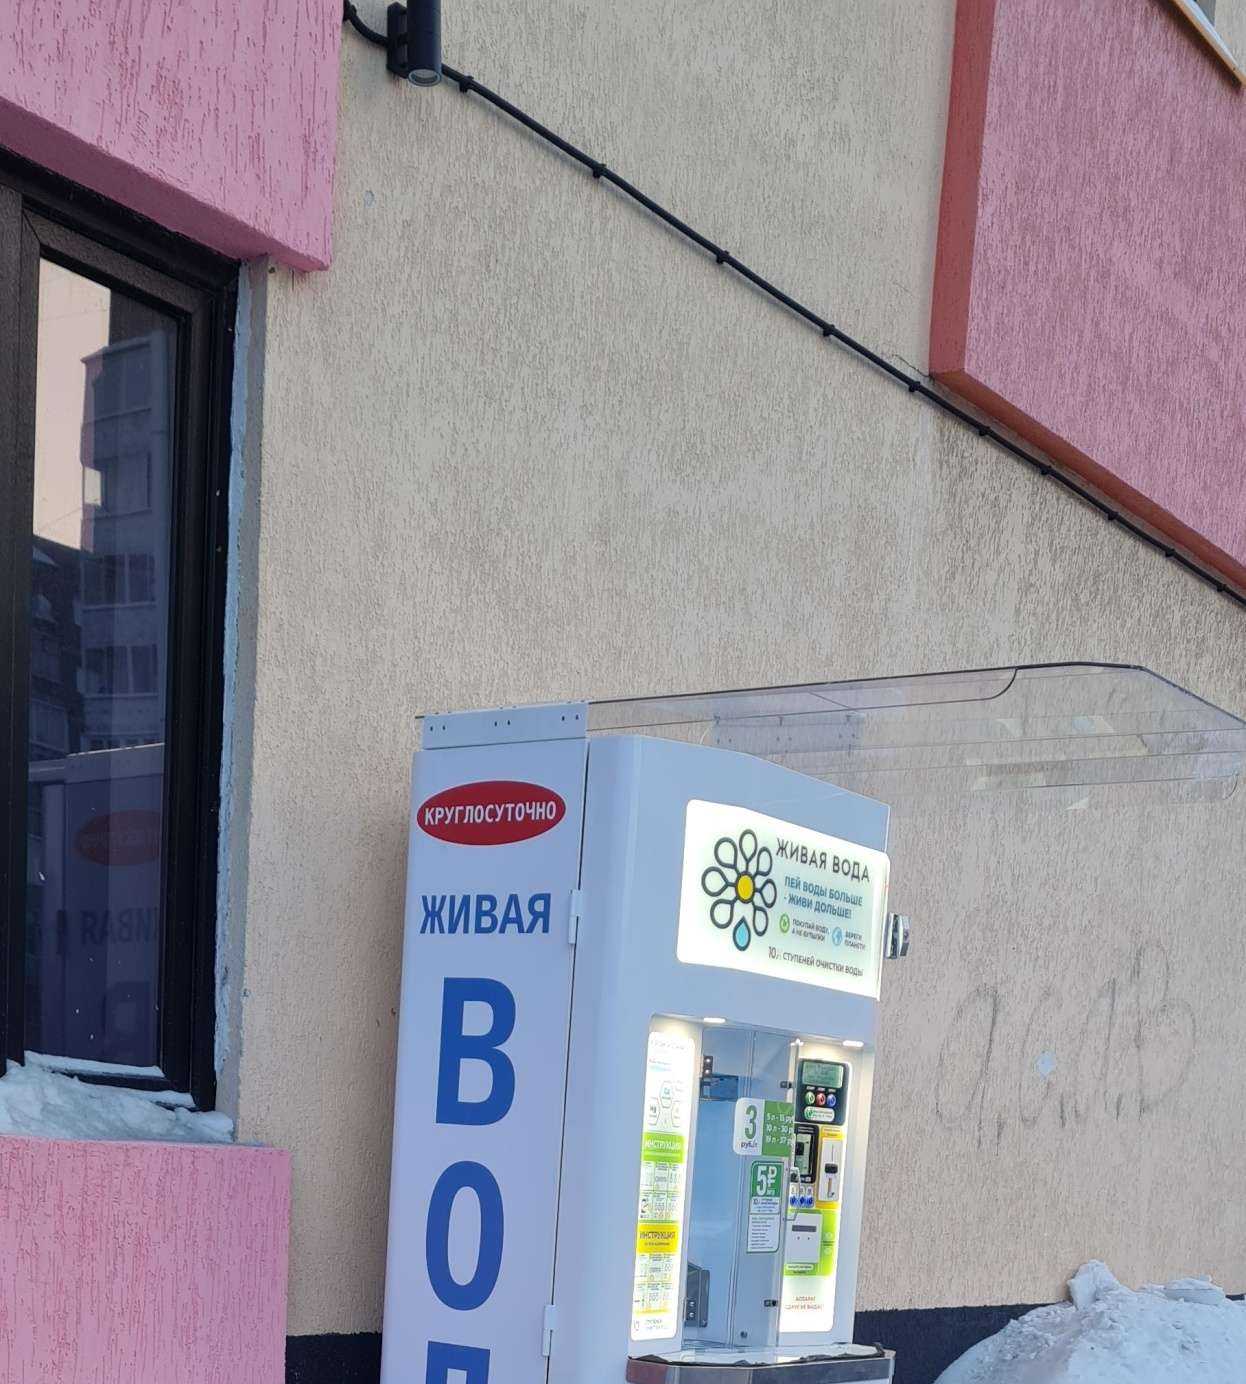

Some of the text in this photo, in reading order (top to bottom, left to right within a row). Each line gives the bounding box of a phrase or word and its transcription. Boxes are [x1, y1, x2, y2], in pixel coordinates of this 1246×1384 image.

[424, 801, 557, 826] КРУГЛОСУТОЧНО
[775, 837, 871, 883] ЖИВАЯ ВОДА
[784, 875, 863, 906] ПЕЙ ВОДЫ БОЛЬШЕ
[788, 893, 813, 909] ЖИВИ
[814, 900, 852, 919] ДОЛЬШЕ!
[420, 893, 552, 934] ЖИВАЯ
[782, 952, 815, 967] СТУПЕНЕЙ
[815, 959, 845, 973] ОЧИСТКИ
[845, 966, 864, 977] ВОДЫ
[745, 1105, 757, 1139] 3
